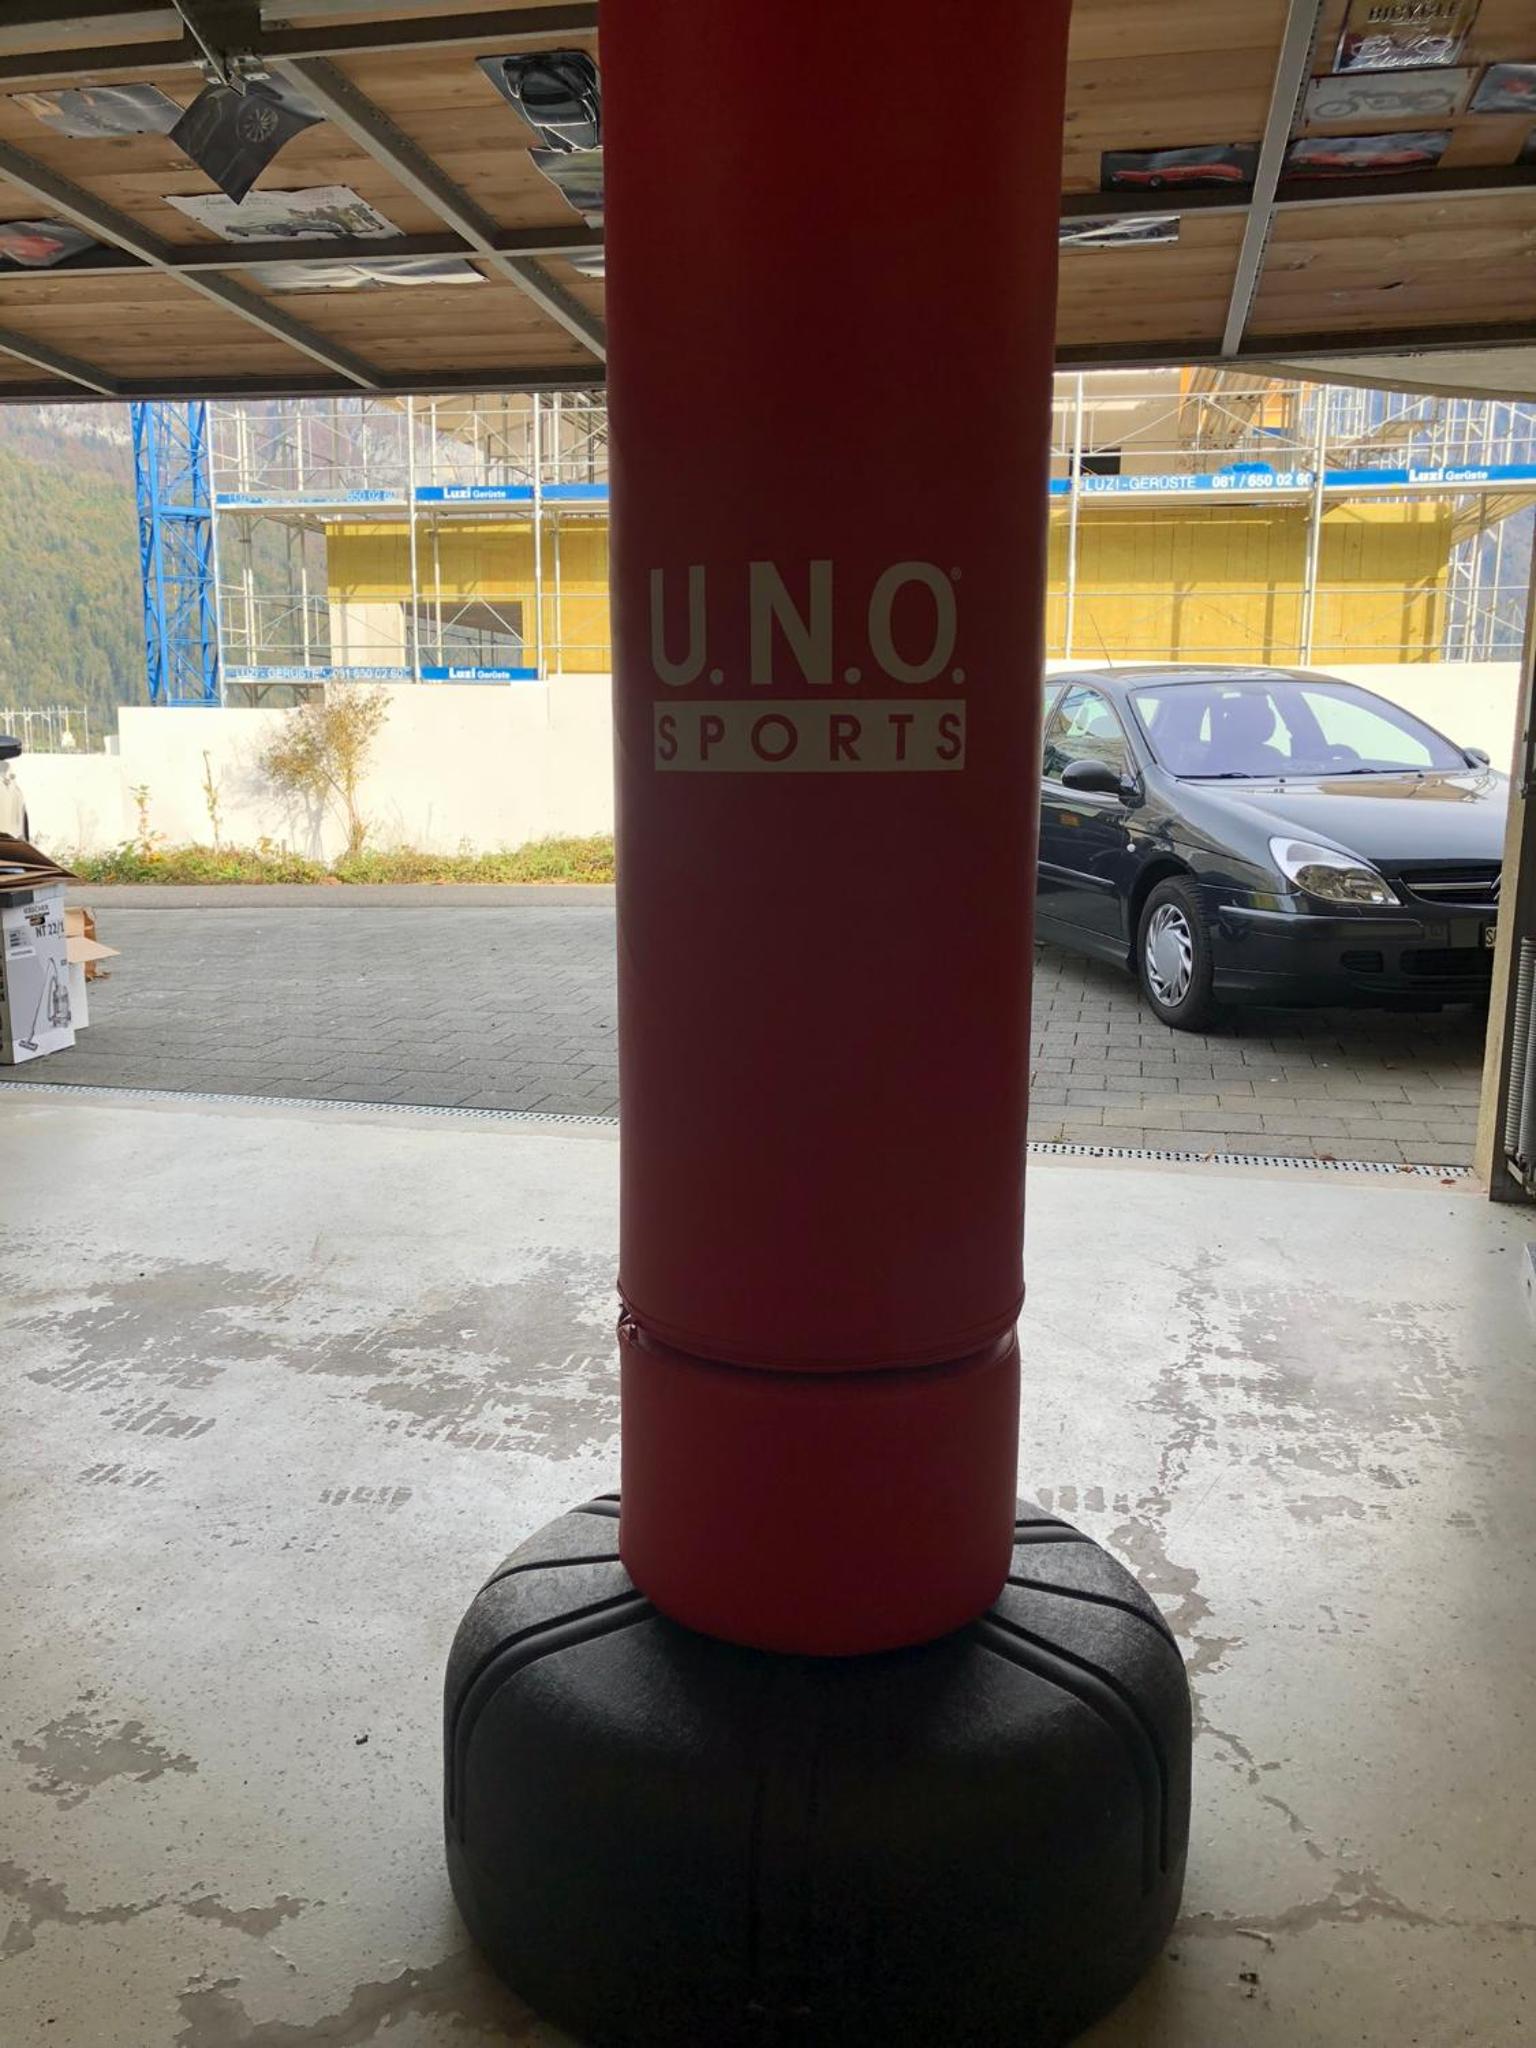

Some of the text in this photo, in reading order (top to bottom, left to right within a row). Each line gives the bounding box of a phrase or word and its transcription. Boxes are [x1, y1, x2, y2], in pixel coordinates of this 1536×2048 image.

[1247, 473, 1273, 487] 650
[1276, 472, 1293, 486] 02
[1409, 467, 1444, 482] Luzi
[443, 486, 471, 499] Luzi
[650, 560, 965, 687] U.N.O.
[449, 667, 476, 679] Luzi
[658, 713, 962, 762] SPORTS
